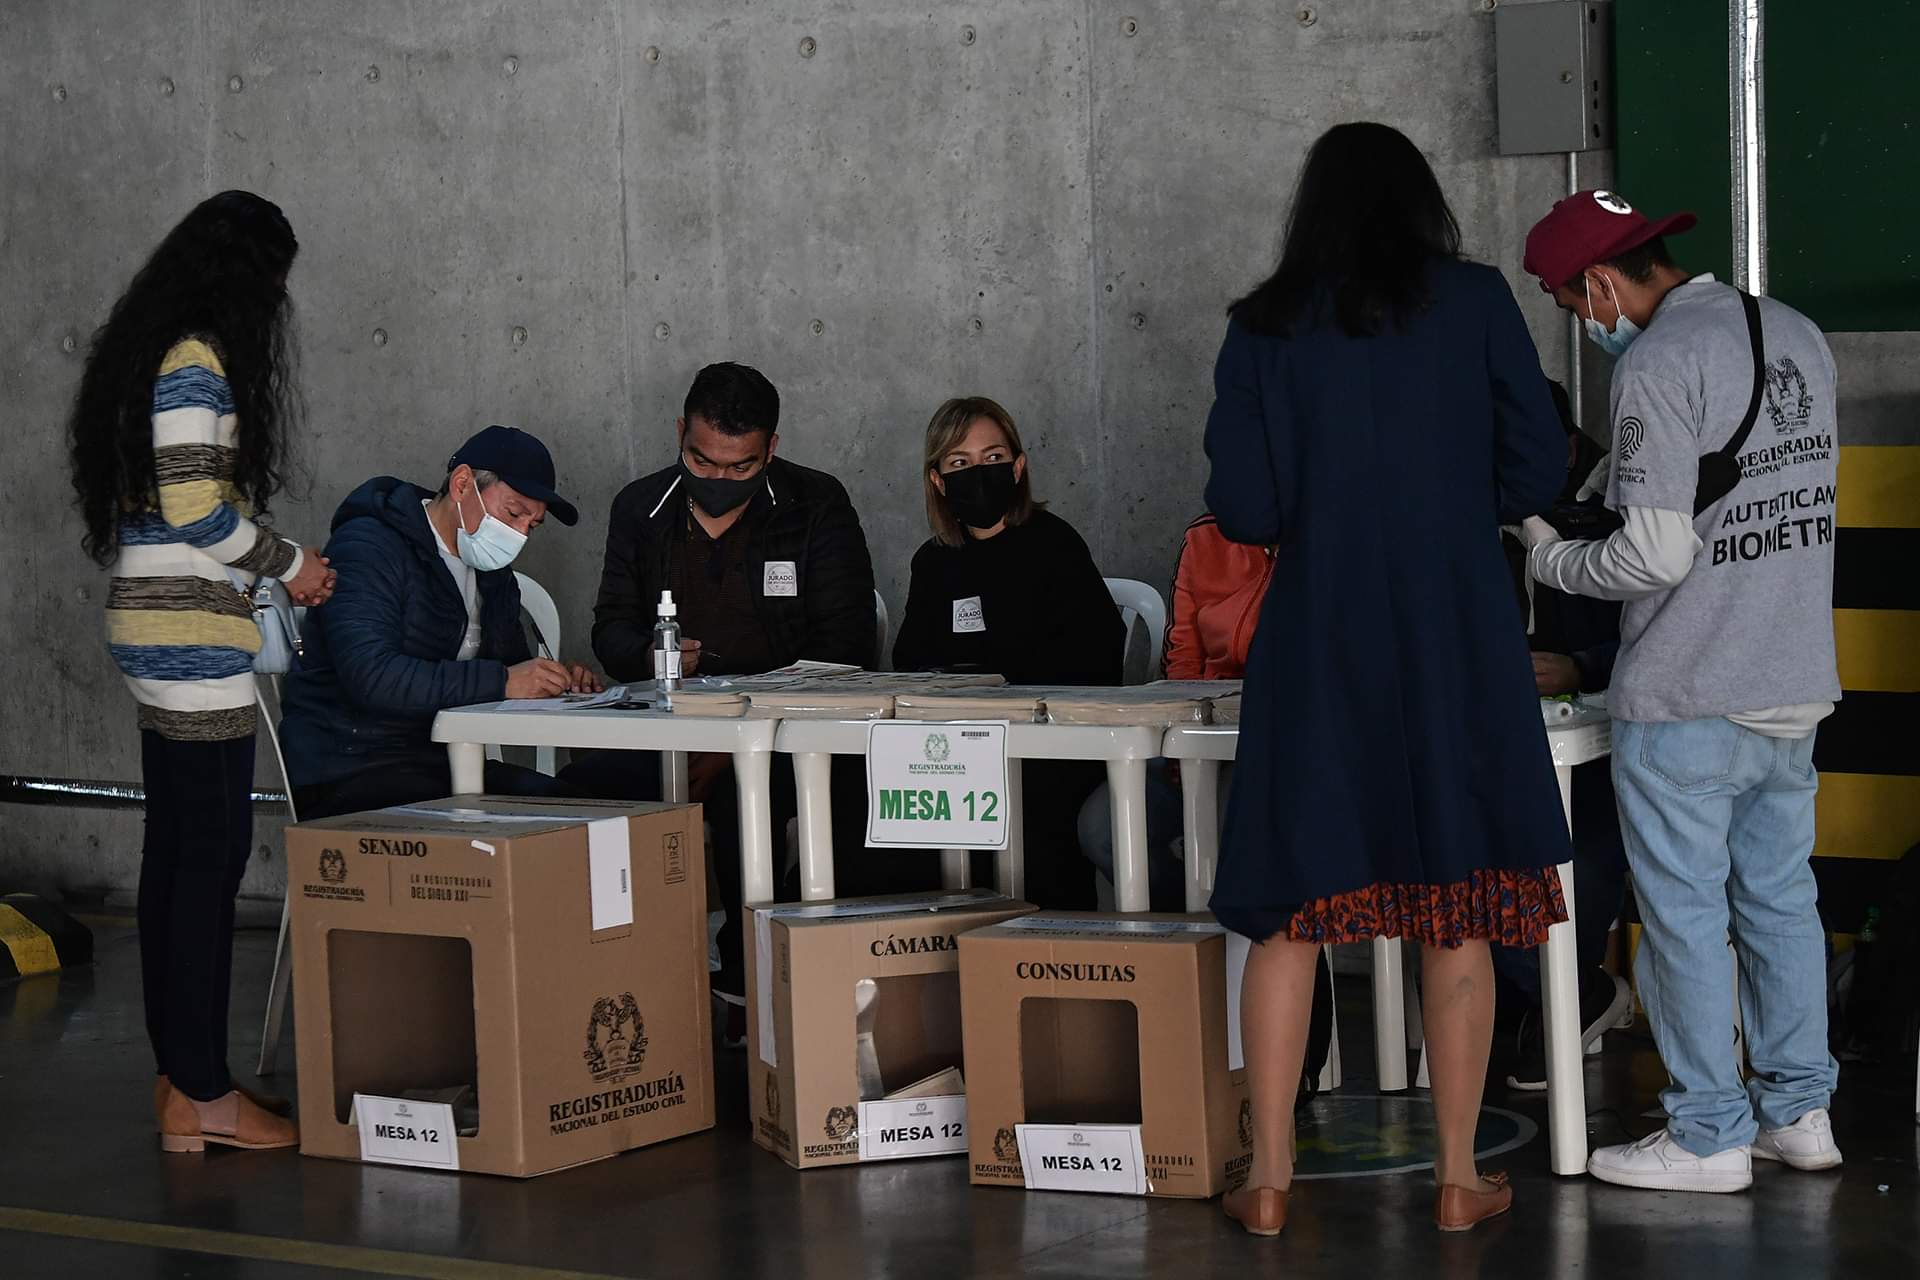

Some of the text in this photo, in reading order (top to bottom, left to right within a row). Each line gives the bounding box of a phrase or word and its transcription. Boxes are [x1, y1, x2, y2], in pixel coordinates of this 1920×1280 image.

[879, 789, 998, 821] MESA 12
[359, 838, 427, 858] SENADO
[411, 886, 469, 902] DEL SIGLO XXI
[870, 934, 958, 957] CÁMARA
[1016, 962, 1136, 982] CONSULTAS
[549, 1071, 685, 1122] REGISTRADURÍA
[550, 1094, 685, 1136] NACIONAL DEL ESTADO CIVIL
[375, 1124, 439, 1143] MESA 12
[880, 1123, 963, 1143] MESA 12
[1041, 1155, 1122, 1172] MESA 12
[1151, 1167, 1167, 1180] XXI
